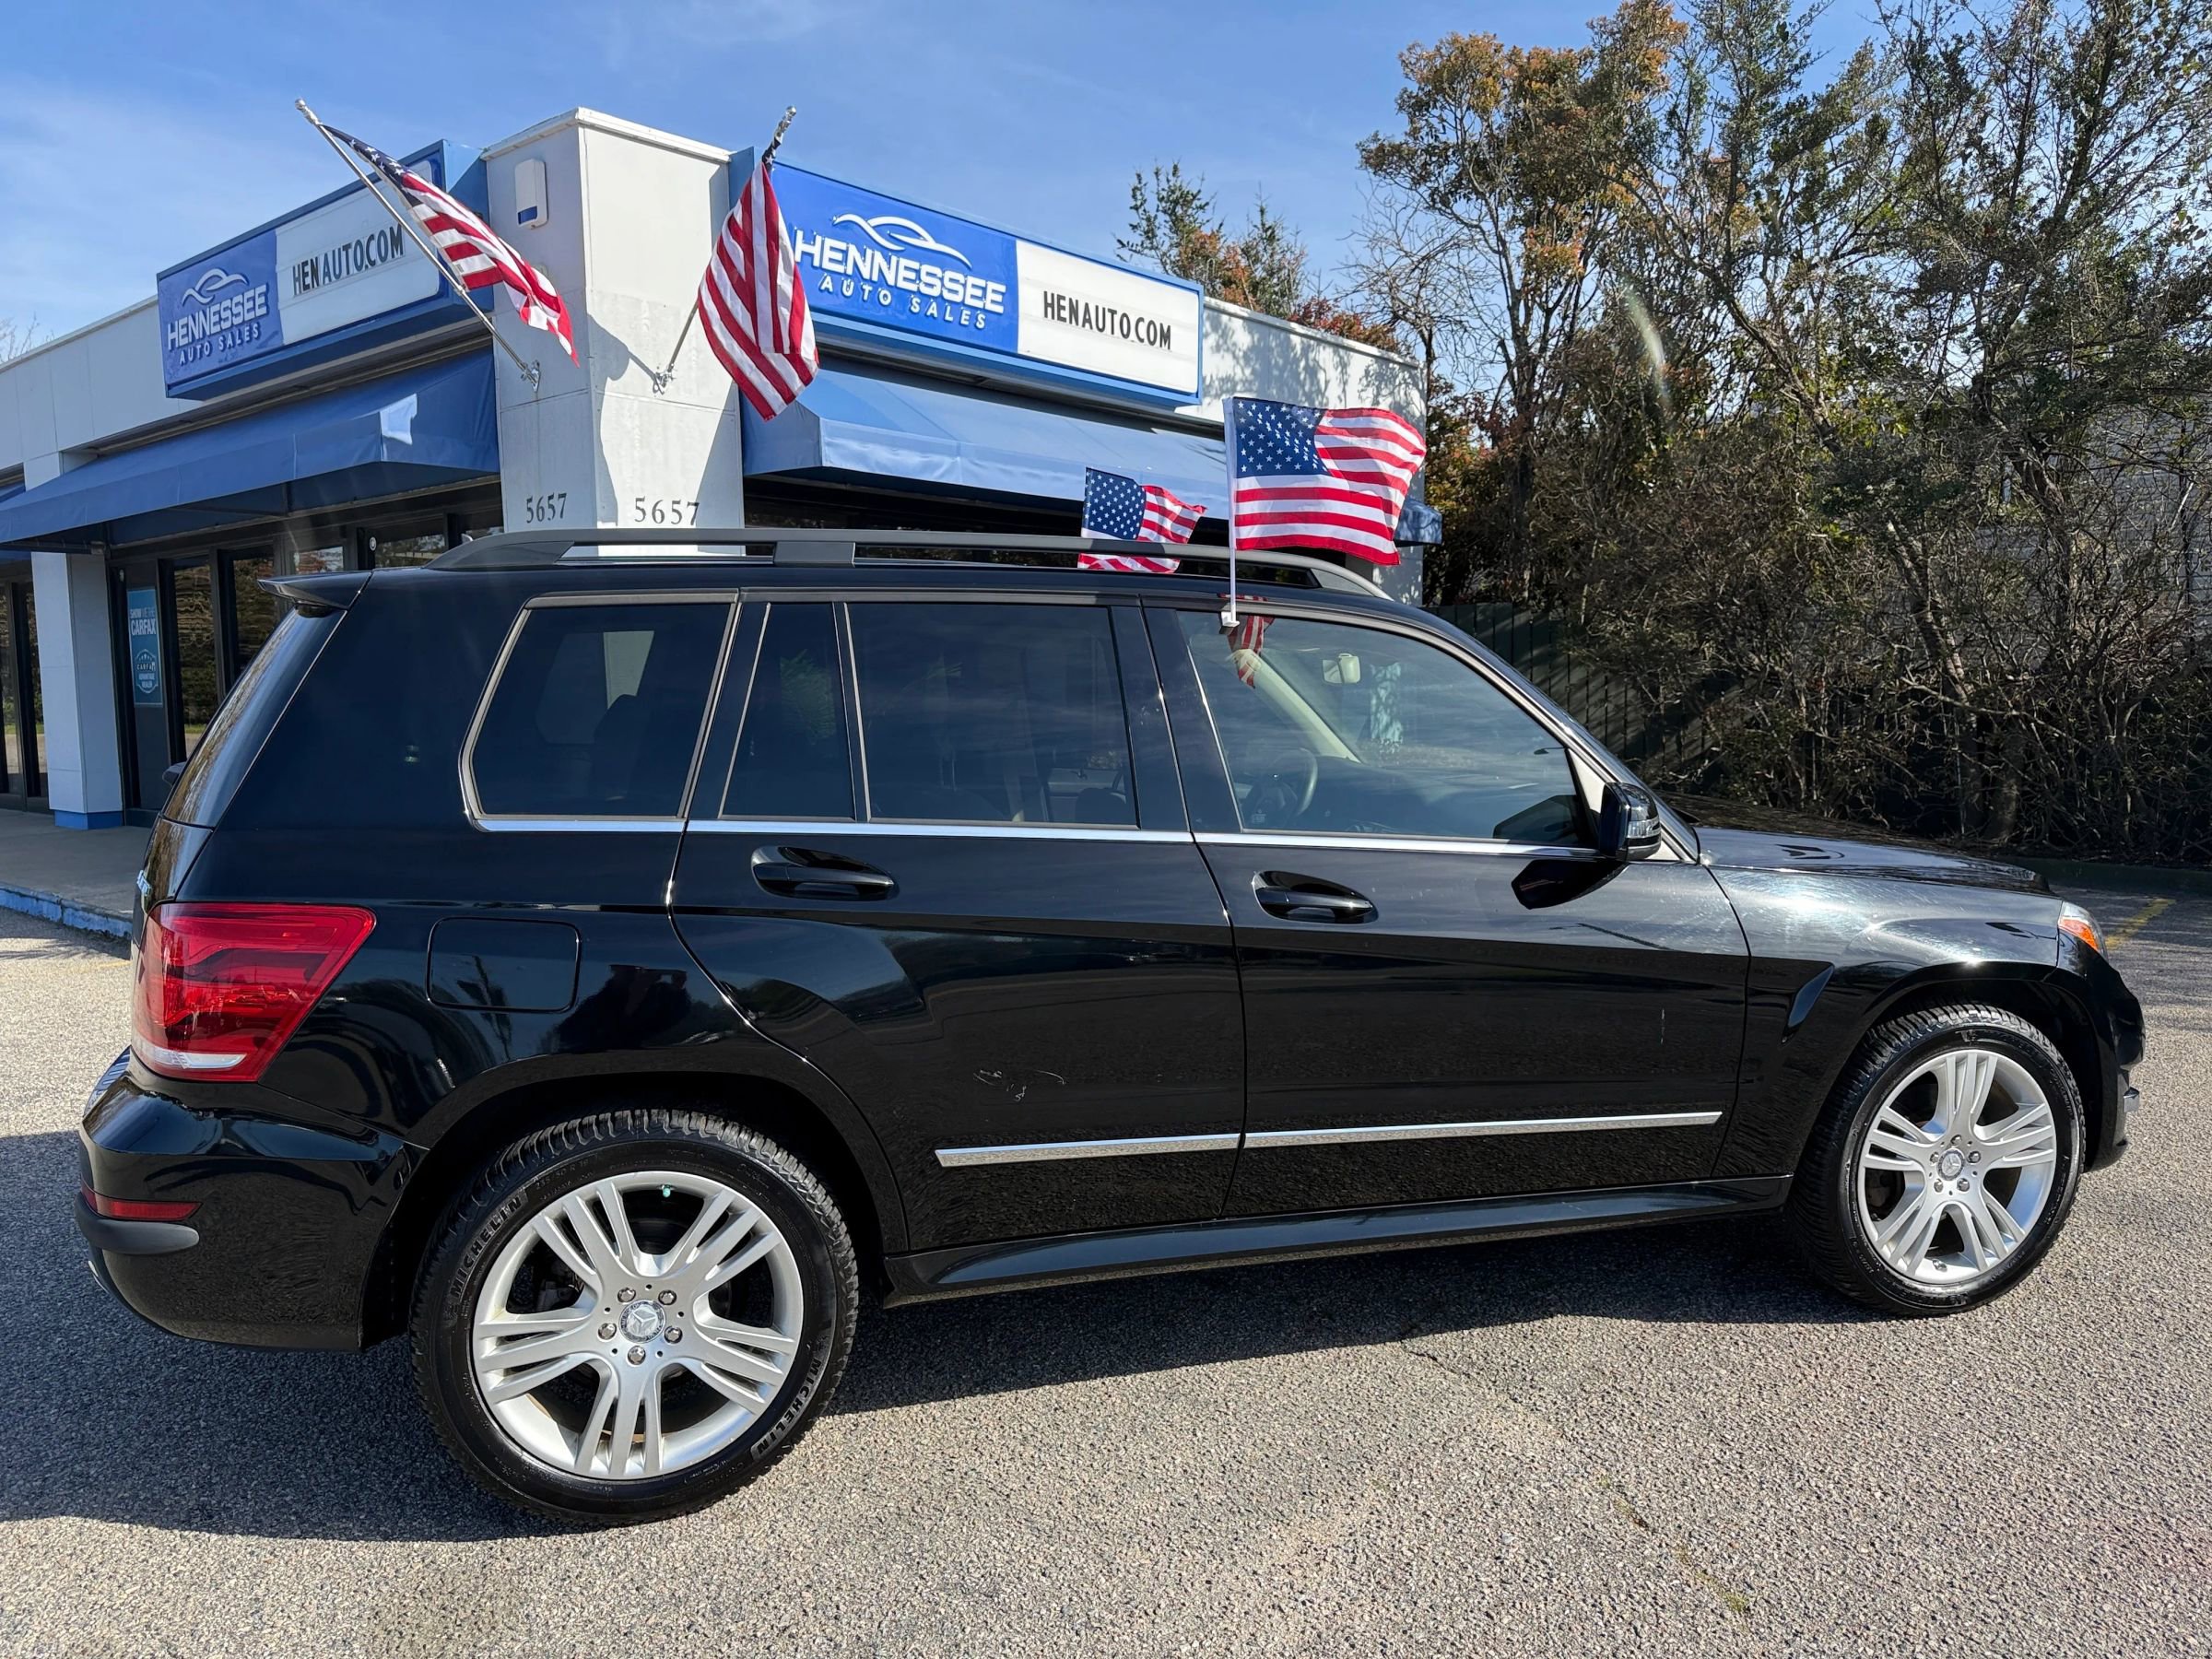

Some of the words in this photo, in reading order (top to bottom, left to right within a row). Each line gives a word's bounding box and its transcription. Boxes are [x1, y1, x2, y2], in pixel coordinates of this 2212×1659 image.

[794, 228, 1006, 314] HENNESSEE
[167, 283, 269, 351] HENNESSEE
[819, 275, 892, 306] AUTO
[910, 297, 987, 330] SALES
[179, 340, 211, 365] AUTO
[218, 323, 261, 349] SALES
[526, 492, 567, 524] 5657
[634, 495, 700, 526] 5657
[131, 619, 156, 635] CARFAX
[450, 1194, 523, 1300] MICHELIN
[757, 1358, 822, 1454] MICHELIN
